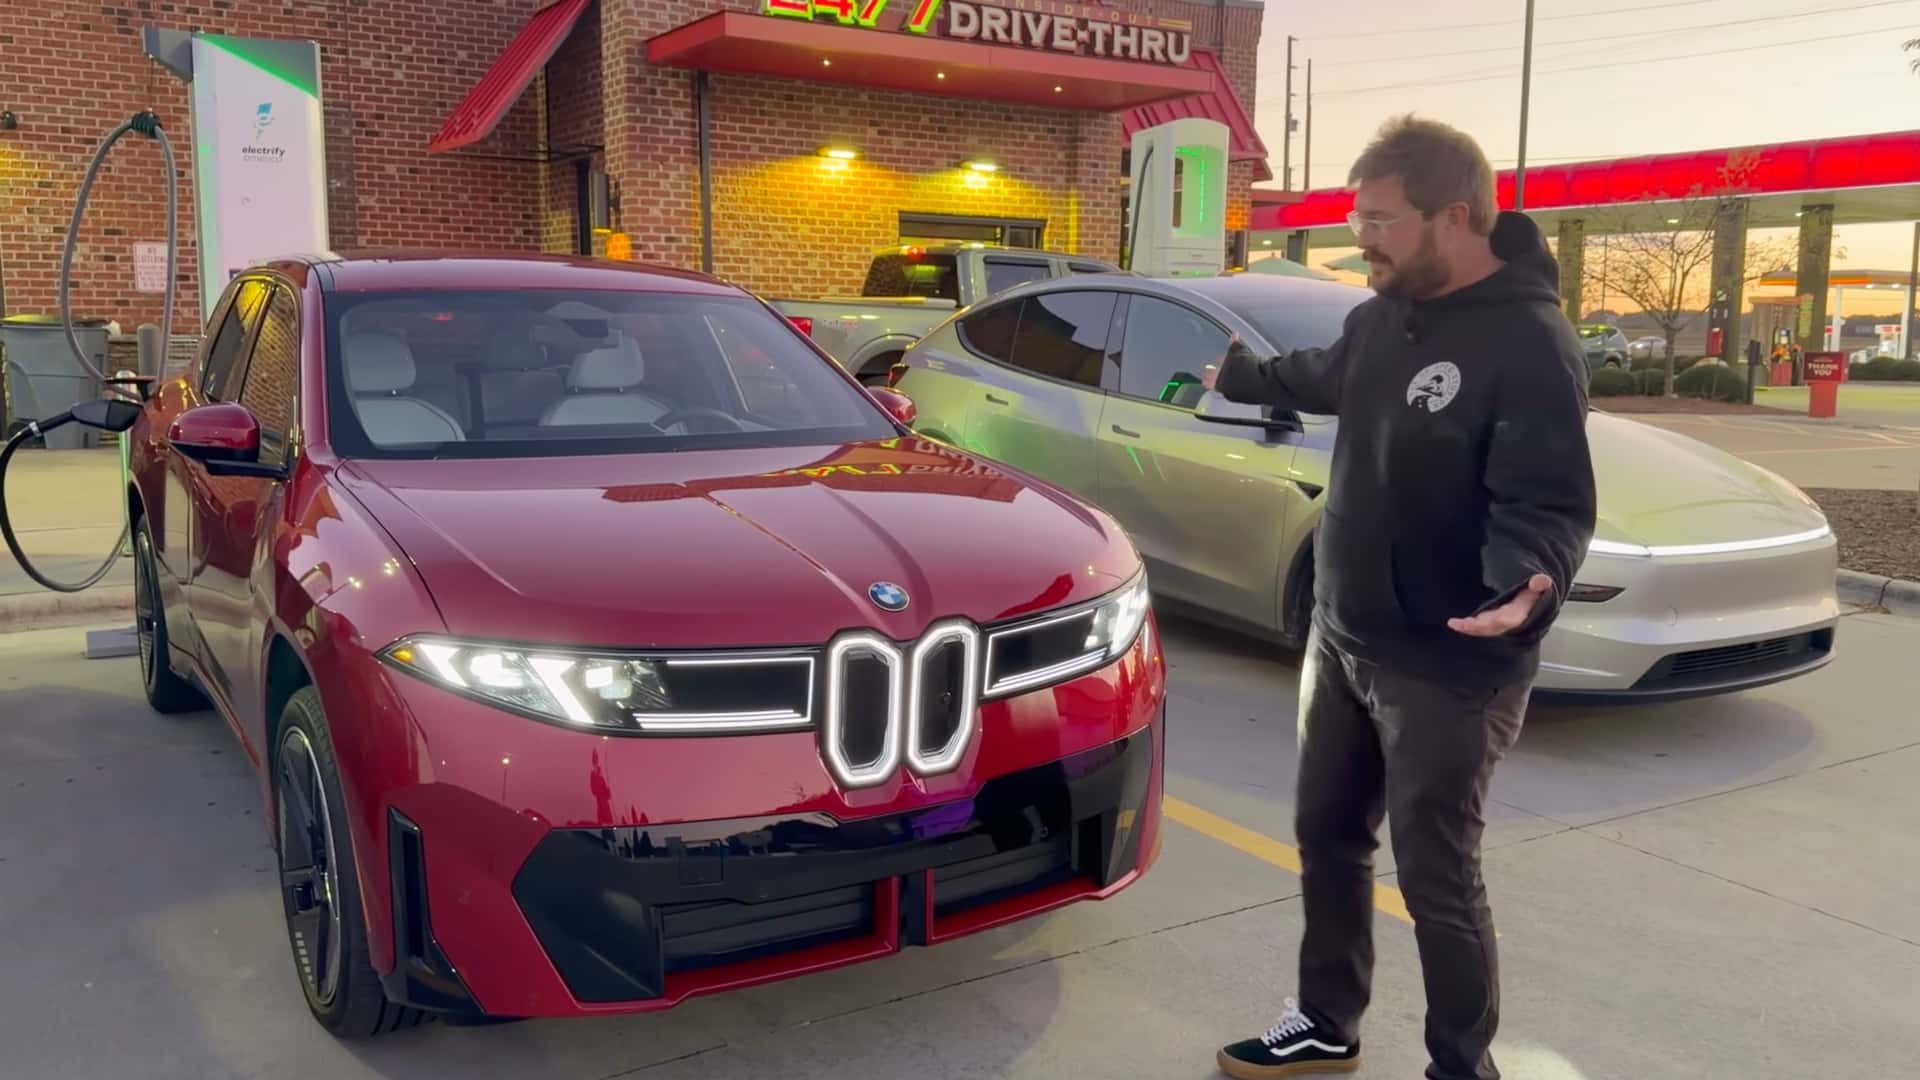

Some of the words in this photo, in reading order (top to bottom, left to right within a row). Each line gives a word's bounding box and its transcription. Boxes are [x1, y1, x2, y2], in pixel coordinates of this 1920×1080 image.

[242, 145, 286, 158] electrify
[1808, 362, 1839, 370] THANK
[1814, 369, 1832, 377] YOU
